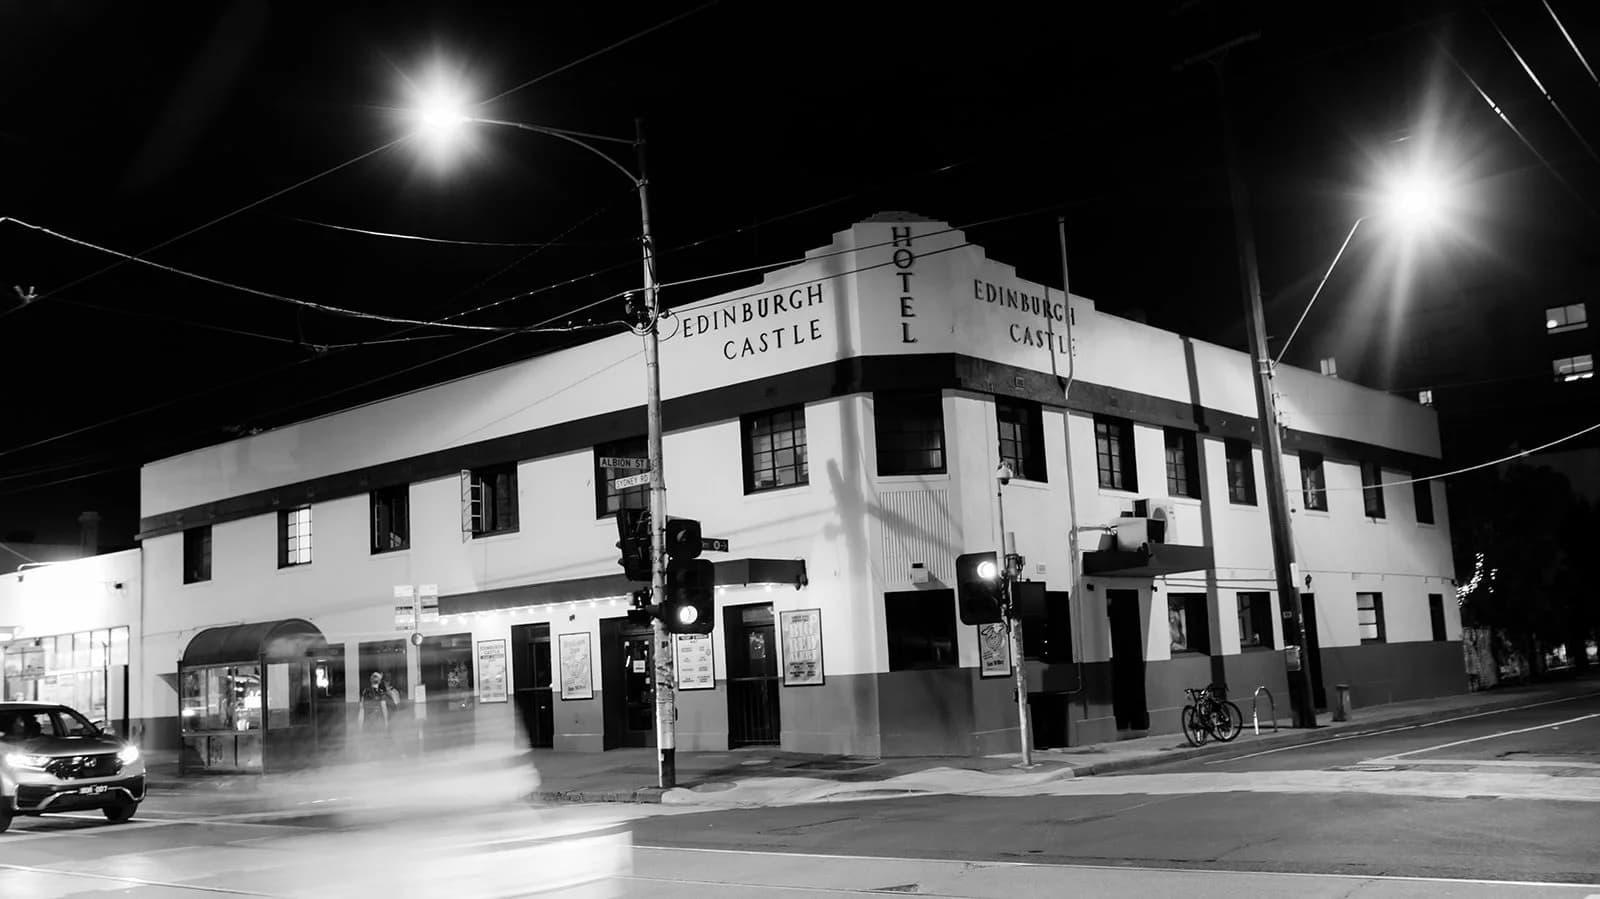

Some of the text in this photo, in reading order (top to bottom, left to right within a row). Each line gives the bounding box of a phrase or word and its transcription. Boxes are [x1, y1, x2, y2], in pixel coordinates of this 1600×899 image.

[891, 226, 918, 344] HOTEL
[683, 283, 824, 338] EDINBURGH
[723, 318, 823, 360] CASTLE
[601, 458, 645, 468] ALBION ST
[616, 474, 649, 489] SYDNEY RD
